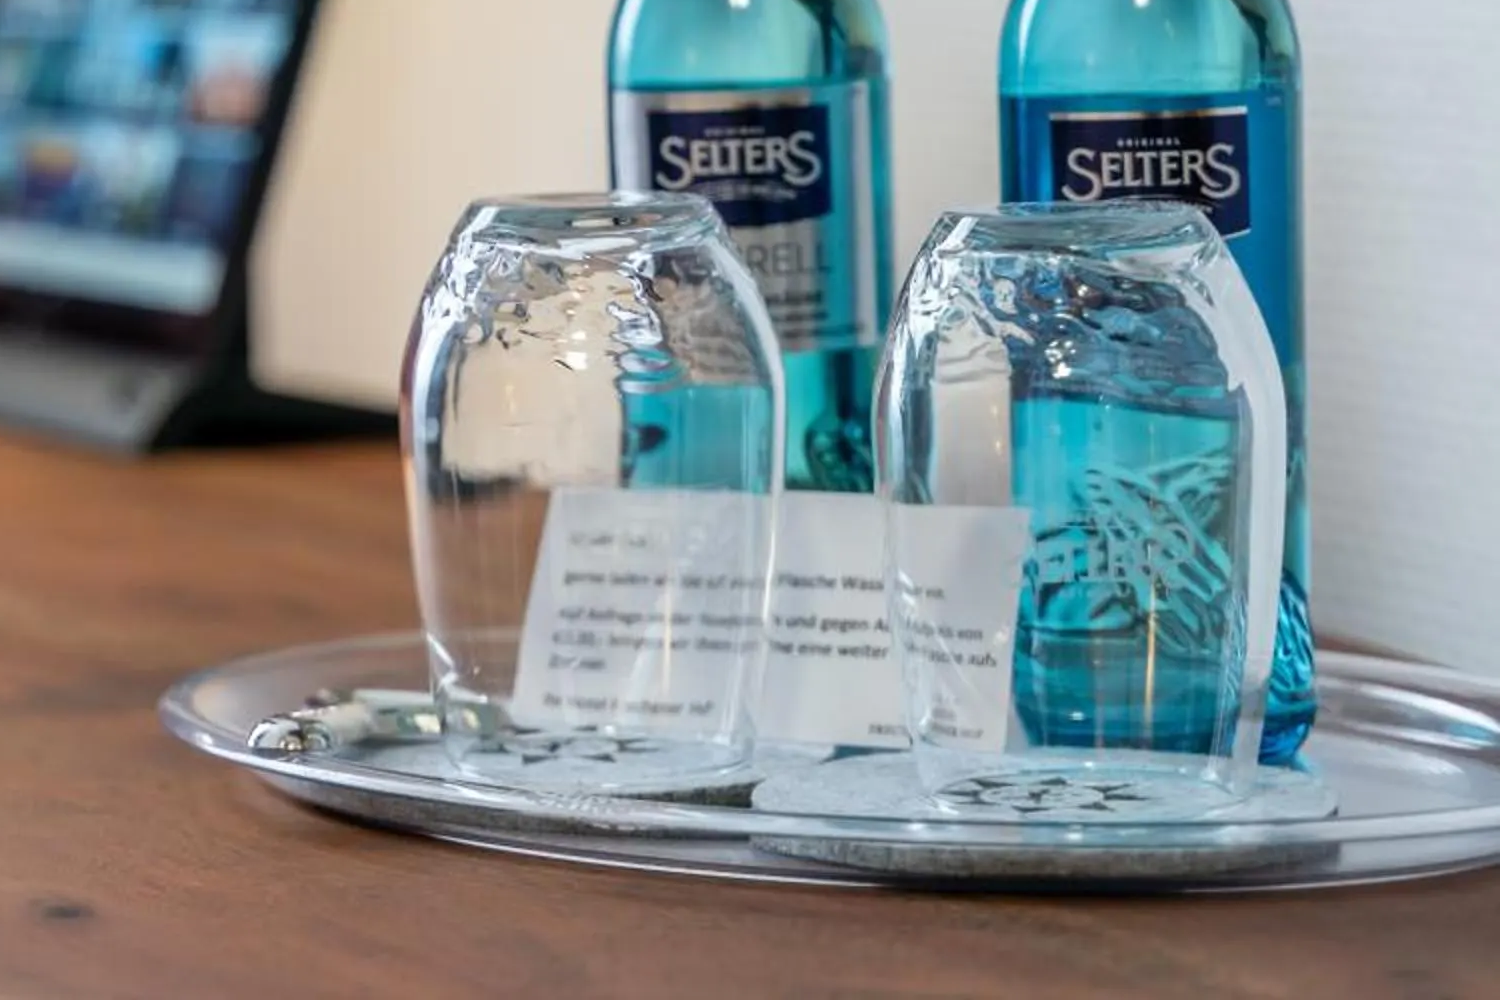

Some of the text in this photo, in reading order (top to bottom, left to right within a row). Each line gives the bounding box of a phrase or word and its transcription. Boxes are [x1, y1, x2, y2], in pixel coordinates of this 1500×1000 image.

[656, 130, 822, 190] SELTERS
[1061, 143, 1242, 200] SELTERS
[819, 618, 869, 634] gegen
